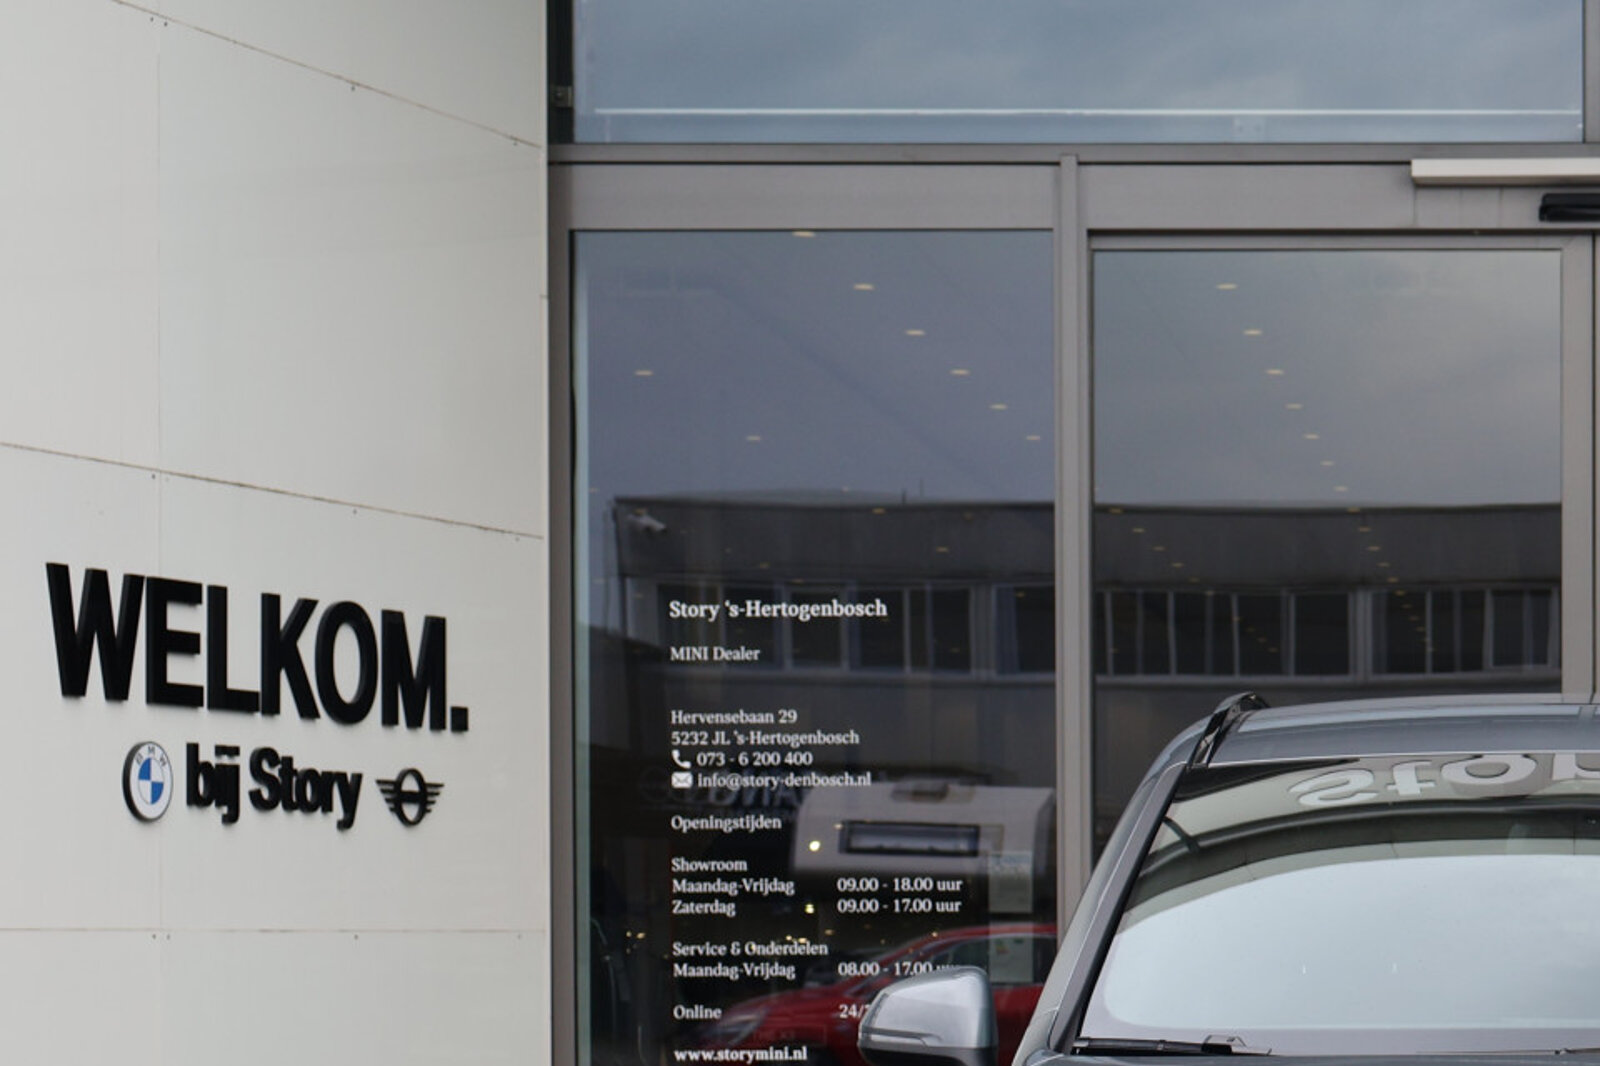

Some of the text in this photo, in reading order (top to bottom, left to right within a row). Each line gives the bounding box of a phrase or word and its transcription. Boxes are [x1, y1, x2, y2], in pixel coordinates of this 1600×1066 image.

[669, 600, 719, 622] Story
[45, 562, 469, 732] WELKOM.
[670, 646, 760, 661] MINI Dealer
[671, 710, 797, 724] Hervensebaan 29
[671, 731, 708, 745] 5232
[712, 731, 730, 745] JL
[697, 752, 725, 766] 073
[738, 752, 748, 766] 6
[752, 752, 781, 766] 200
[784, 752, 812, 766] 400
[186, 742, 363, 830] bij Story
[698, 772, 871, 789] info@story-denbosch.nl
[671, 815, 782, 832] Openingstijden
[671, 857, 747, 872] Showroom
[672, 878, 795, 896] Maandag-Vrijdag
[837, 878, 879, 892] 09.00
[892, 878, 932, 892] 18.00
[937, 880, 962, 891] uur
[672, 899, 736, 918] Zaterdag
[838, 899, 879, 913] 09.00
[892, 899, 932, 913] 17.00
[936, 901, 961, 912] uur
[672, 941, 828, 956] Service & Onderdelen
[673, 962, 796, 981] Maandag-Vrijdag
[838, 962, 879, 976] 08.00
[893, 962, 932, 975] 17.00
[673, 1004, 722, 1019] Online
[674, 1046, 808, 1062] www.storymini.nl
